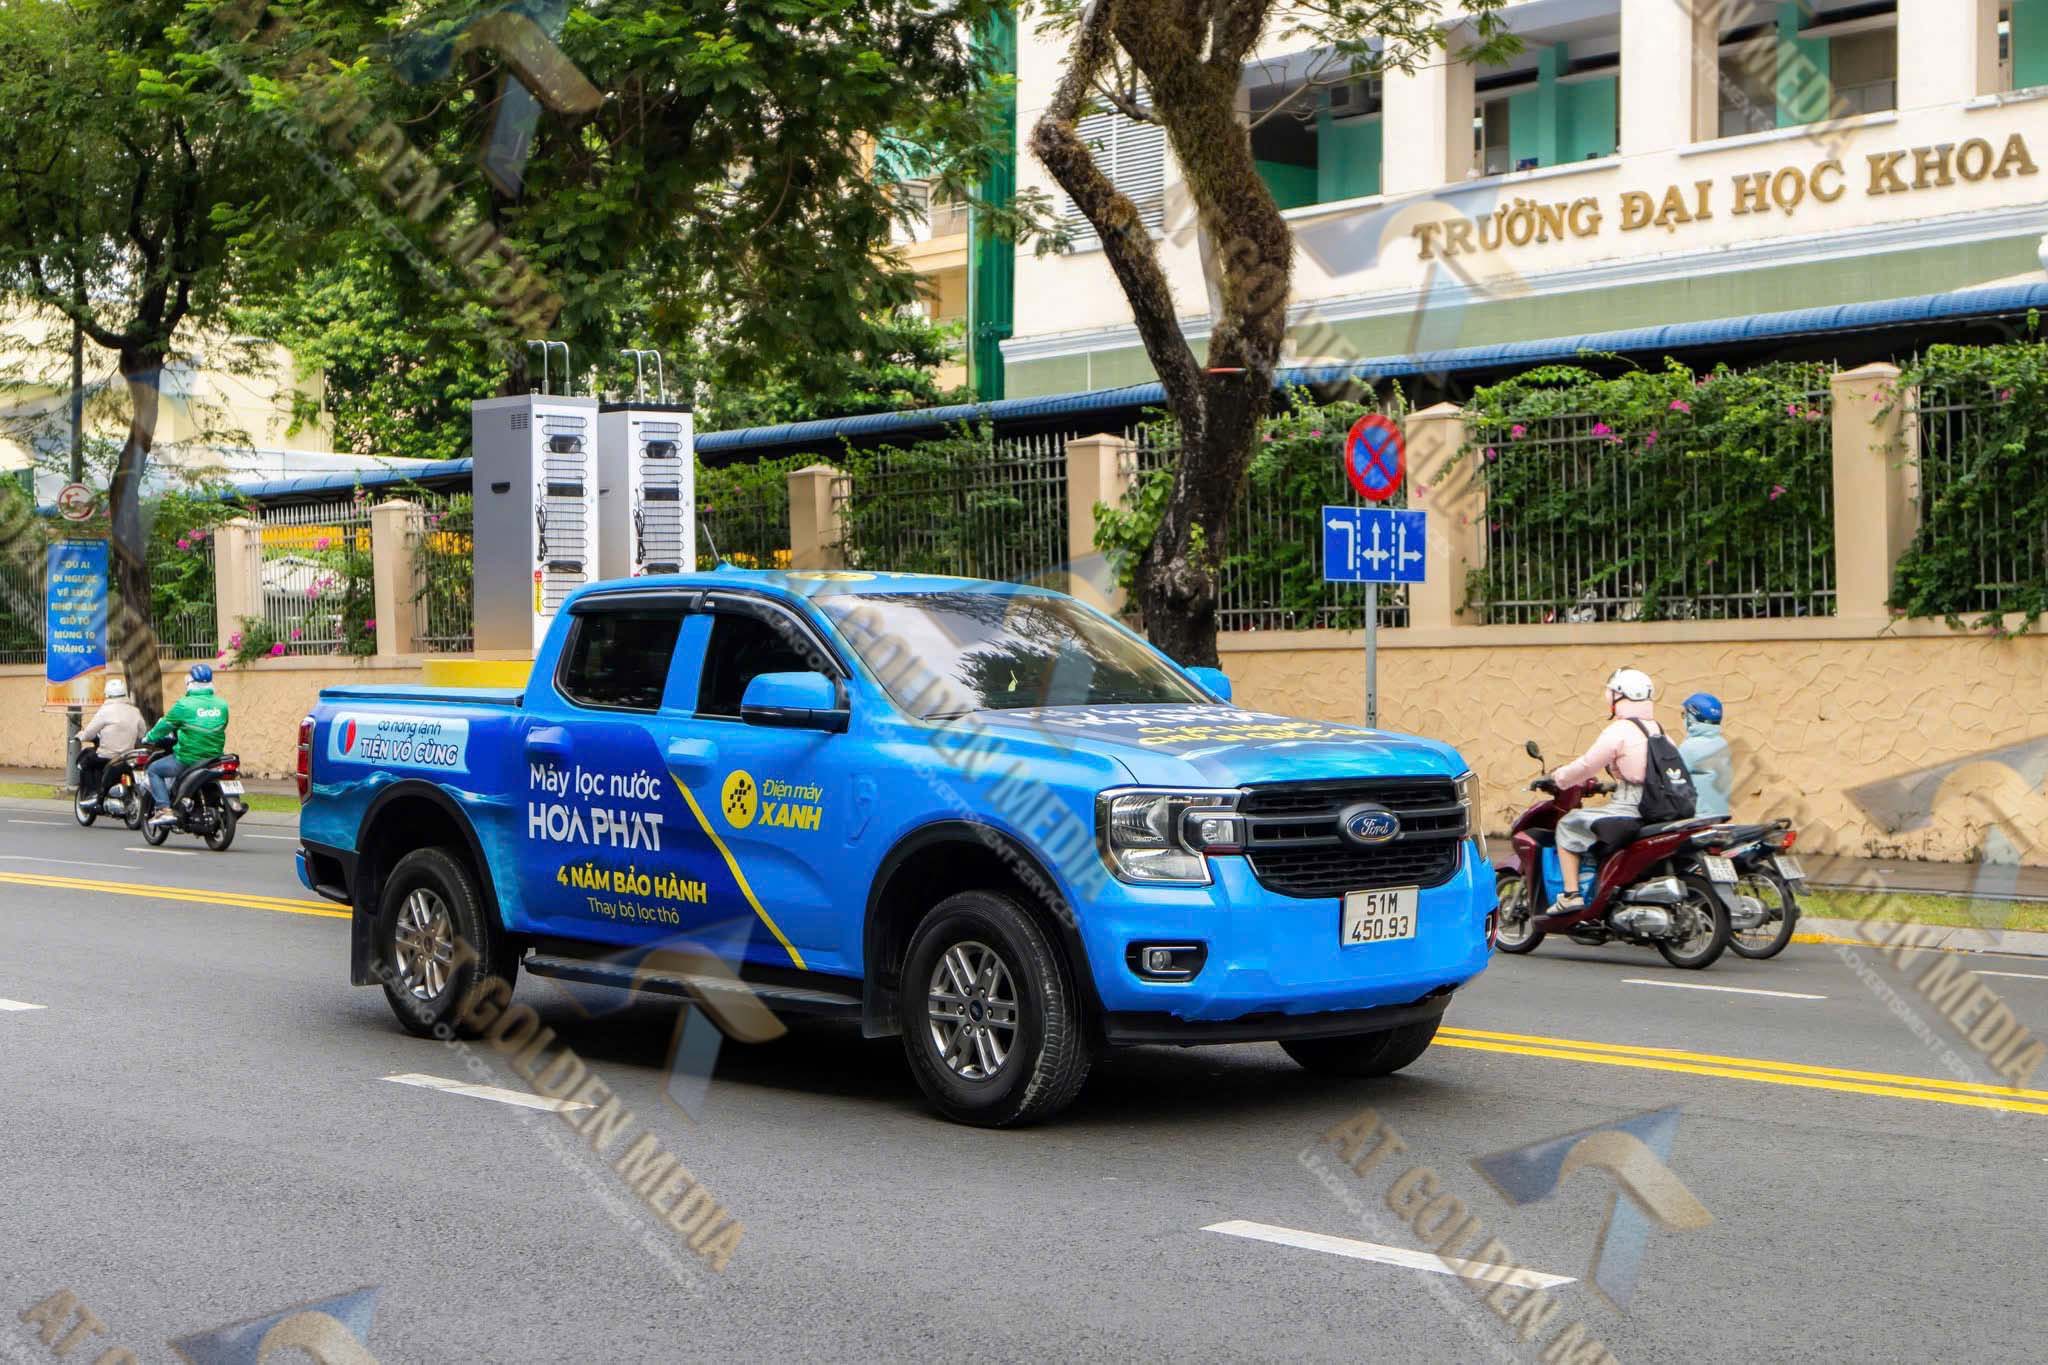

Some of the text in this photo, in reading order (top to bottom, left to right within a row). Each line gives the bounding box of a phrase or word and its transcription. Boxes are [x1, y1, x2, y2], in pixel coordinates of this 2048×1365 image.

[1411, 132, 2039, 260] TRƯỜNG ĐẠI HỌC KHOA
[196, 708, 221, 718] Grab
[361, 735, 458, 766] TIỆN VÔ CÙNG
[529, 763, 661, 801] Máy lọc nước
[762, 779, 823, 804] Điện máy
[591, 807, 664, 852] PHÁT
[758, 801, 823, 831] XANH
[1360, 817, 1390, 836] Ford
[556, 862, 708, 905] 4 NĂM BẢO HÀNH
[586, 896, 681, 925] Thay bộ lọc thô
[1366, 892, 1399, 917] 51M
[1351, 915, 1410, 942] 450.93
